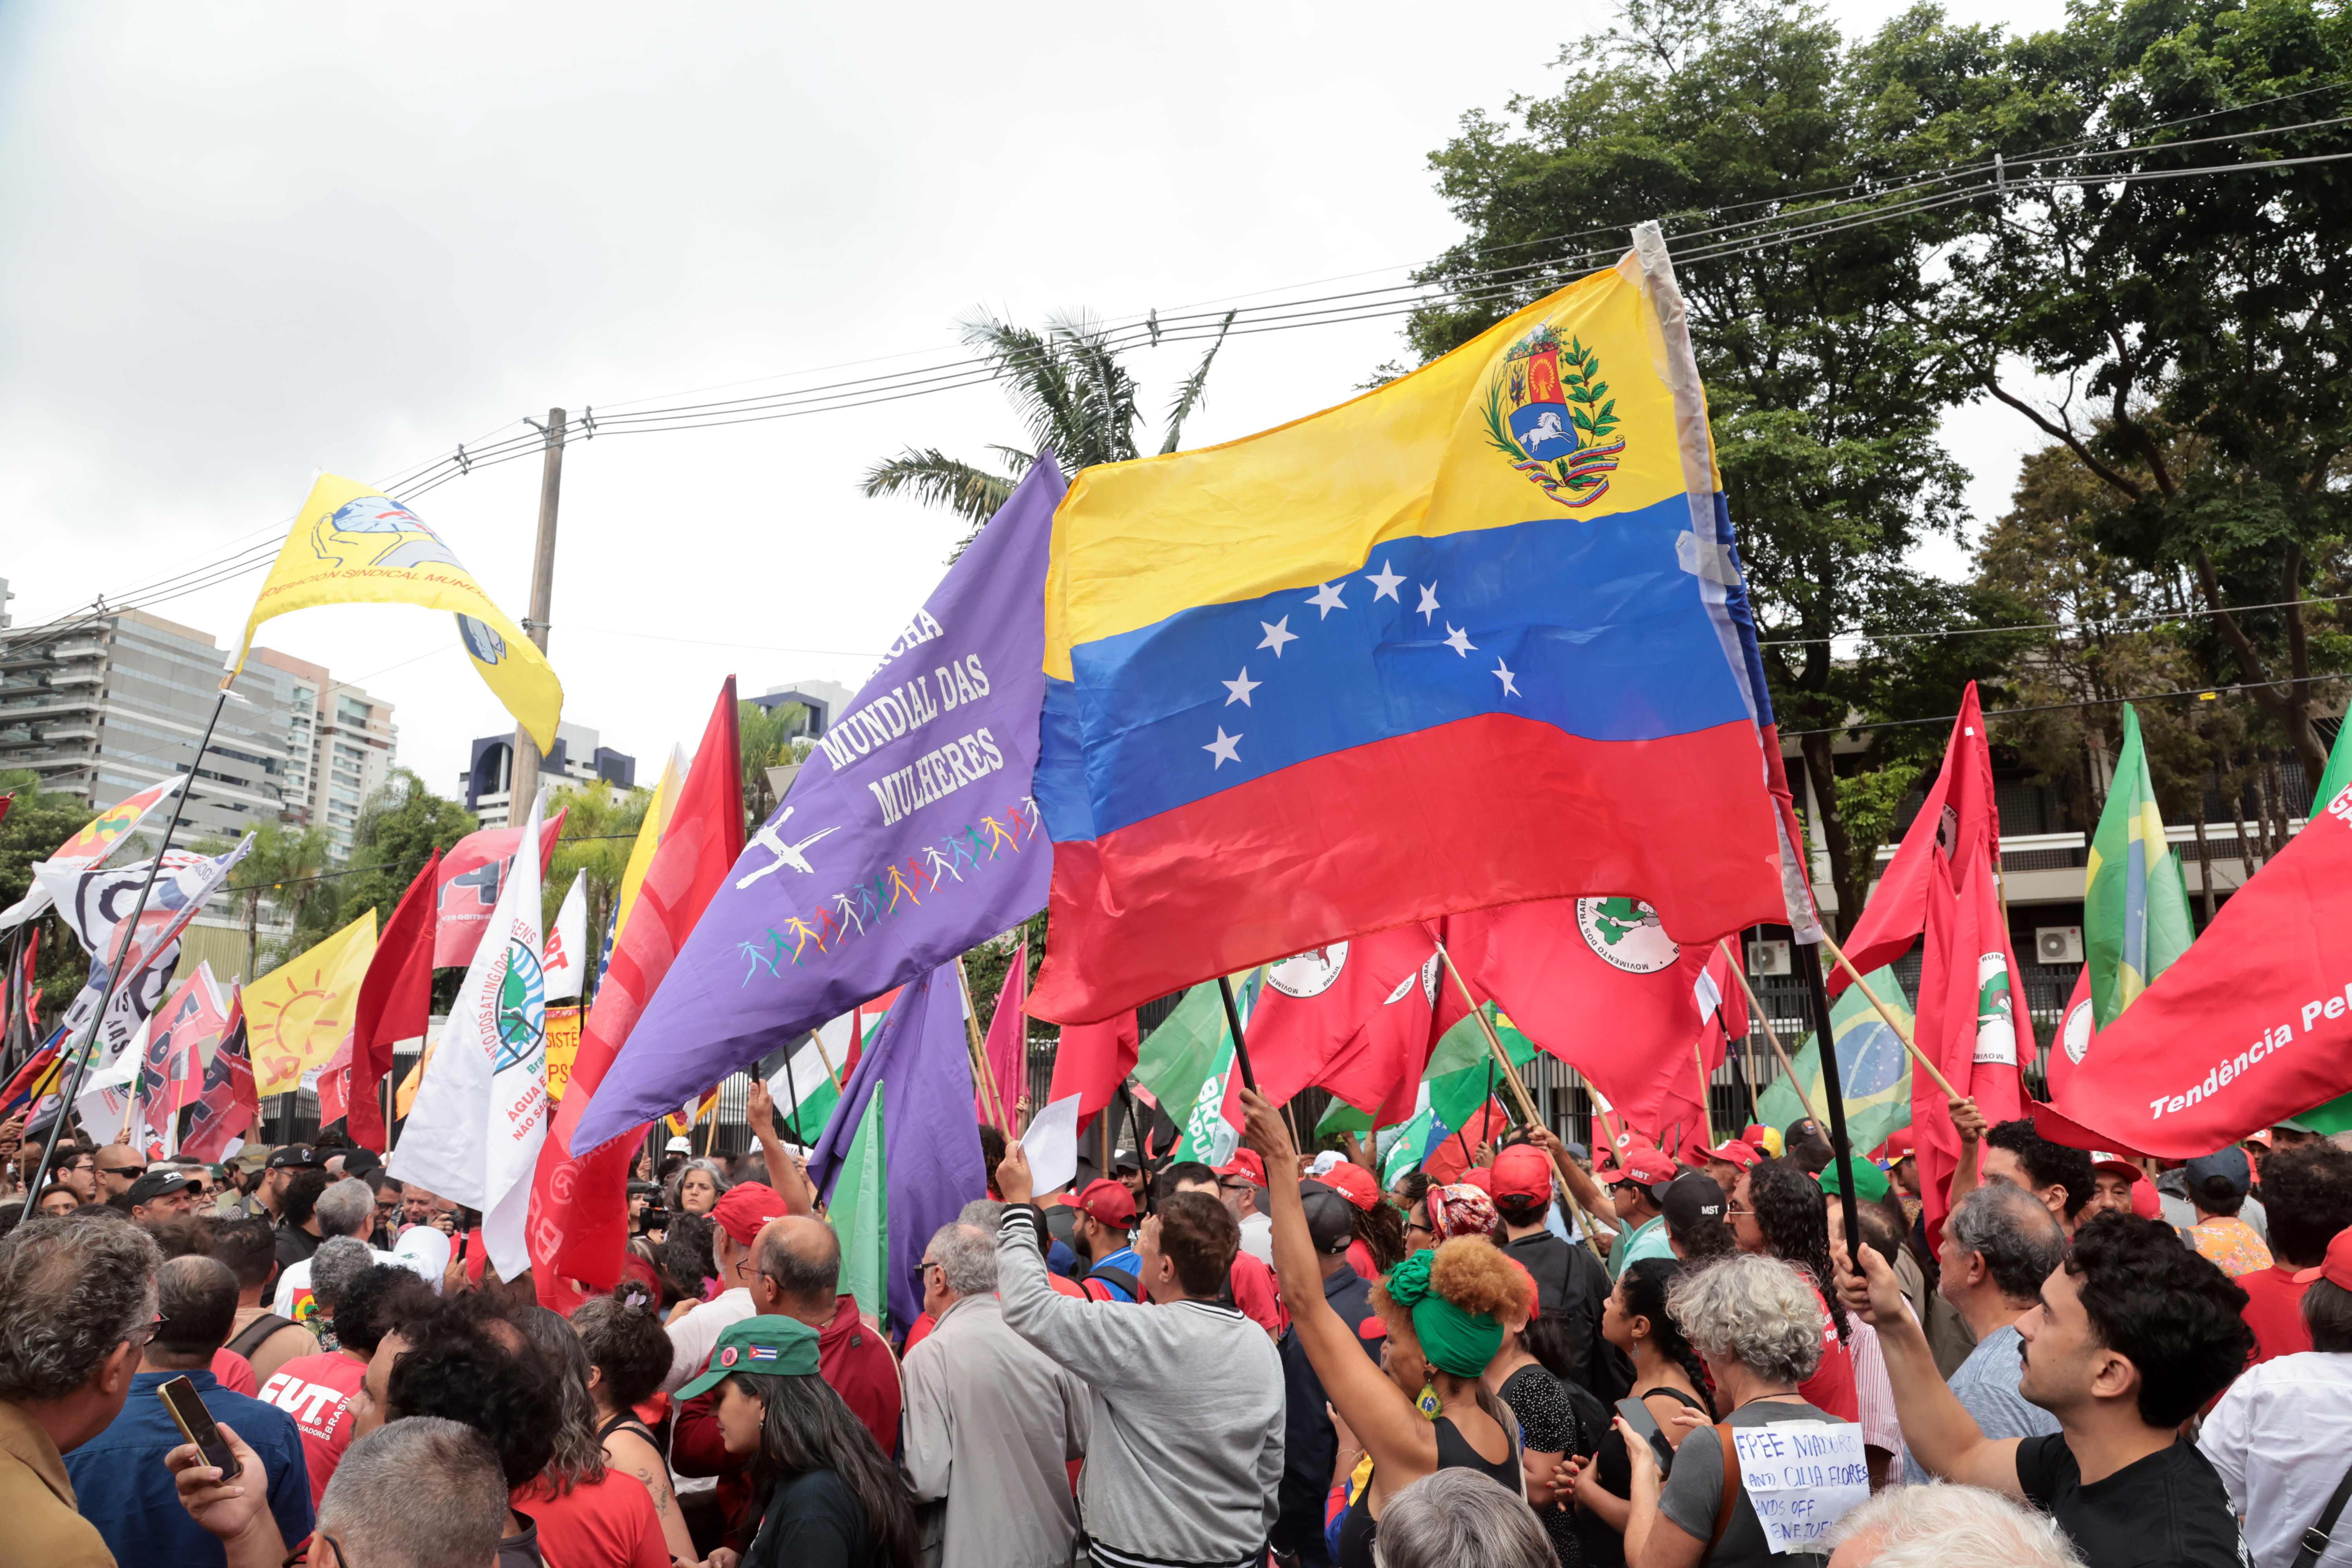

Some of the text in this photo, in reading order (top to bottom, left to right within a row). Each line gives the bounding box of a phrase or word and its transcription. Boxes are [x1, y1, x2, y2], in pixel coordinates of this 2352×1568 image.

[342, 570, 420, 579] SINDICAL
[818, 653, 990, 771] MUNDIAL DAS
[868, 727, 1004, 826] MULHERES
[1584, 928, 1598, 946] DOS
[1598, 946, 1649, 970] MOVIMENTO
[1323, 965, 1341, 987] BRASIL
[1396, 980, 1412, 997] BRASIL
[546, 1026, 580, 1048] SISTÊ
[2150, 1023, 2294, 1120] Tendência
[506, 1086, 541, 1122] ÁGUA
[512, 1117, 535, 1141] NÃO
[1240, 1167, 1256, 1179] MST
[1631, 1169, 1650, 1180] MST
[1337, 1186, 1354, 1198] MST
[1701, 1205, 1719, 1215] MST
[1736, 1433, 1858, 1461] FREE MADURO
[1748, 1463, 1869, 1487] AND CILIA FLORES
[1791, 1499, 1815, 1519] OFF
